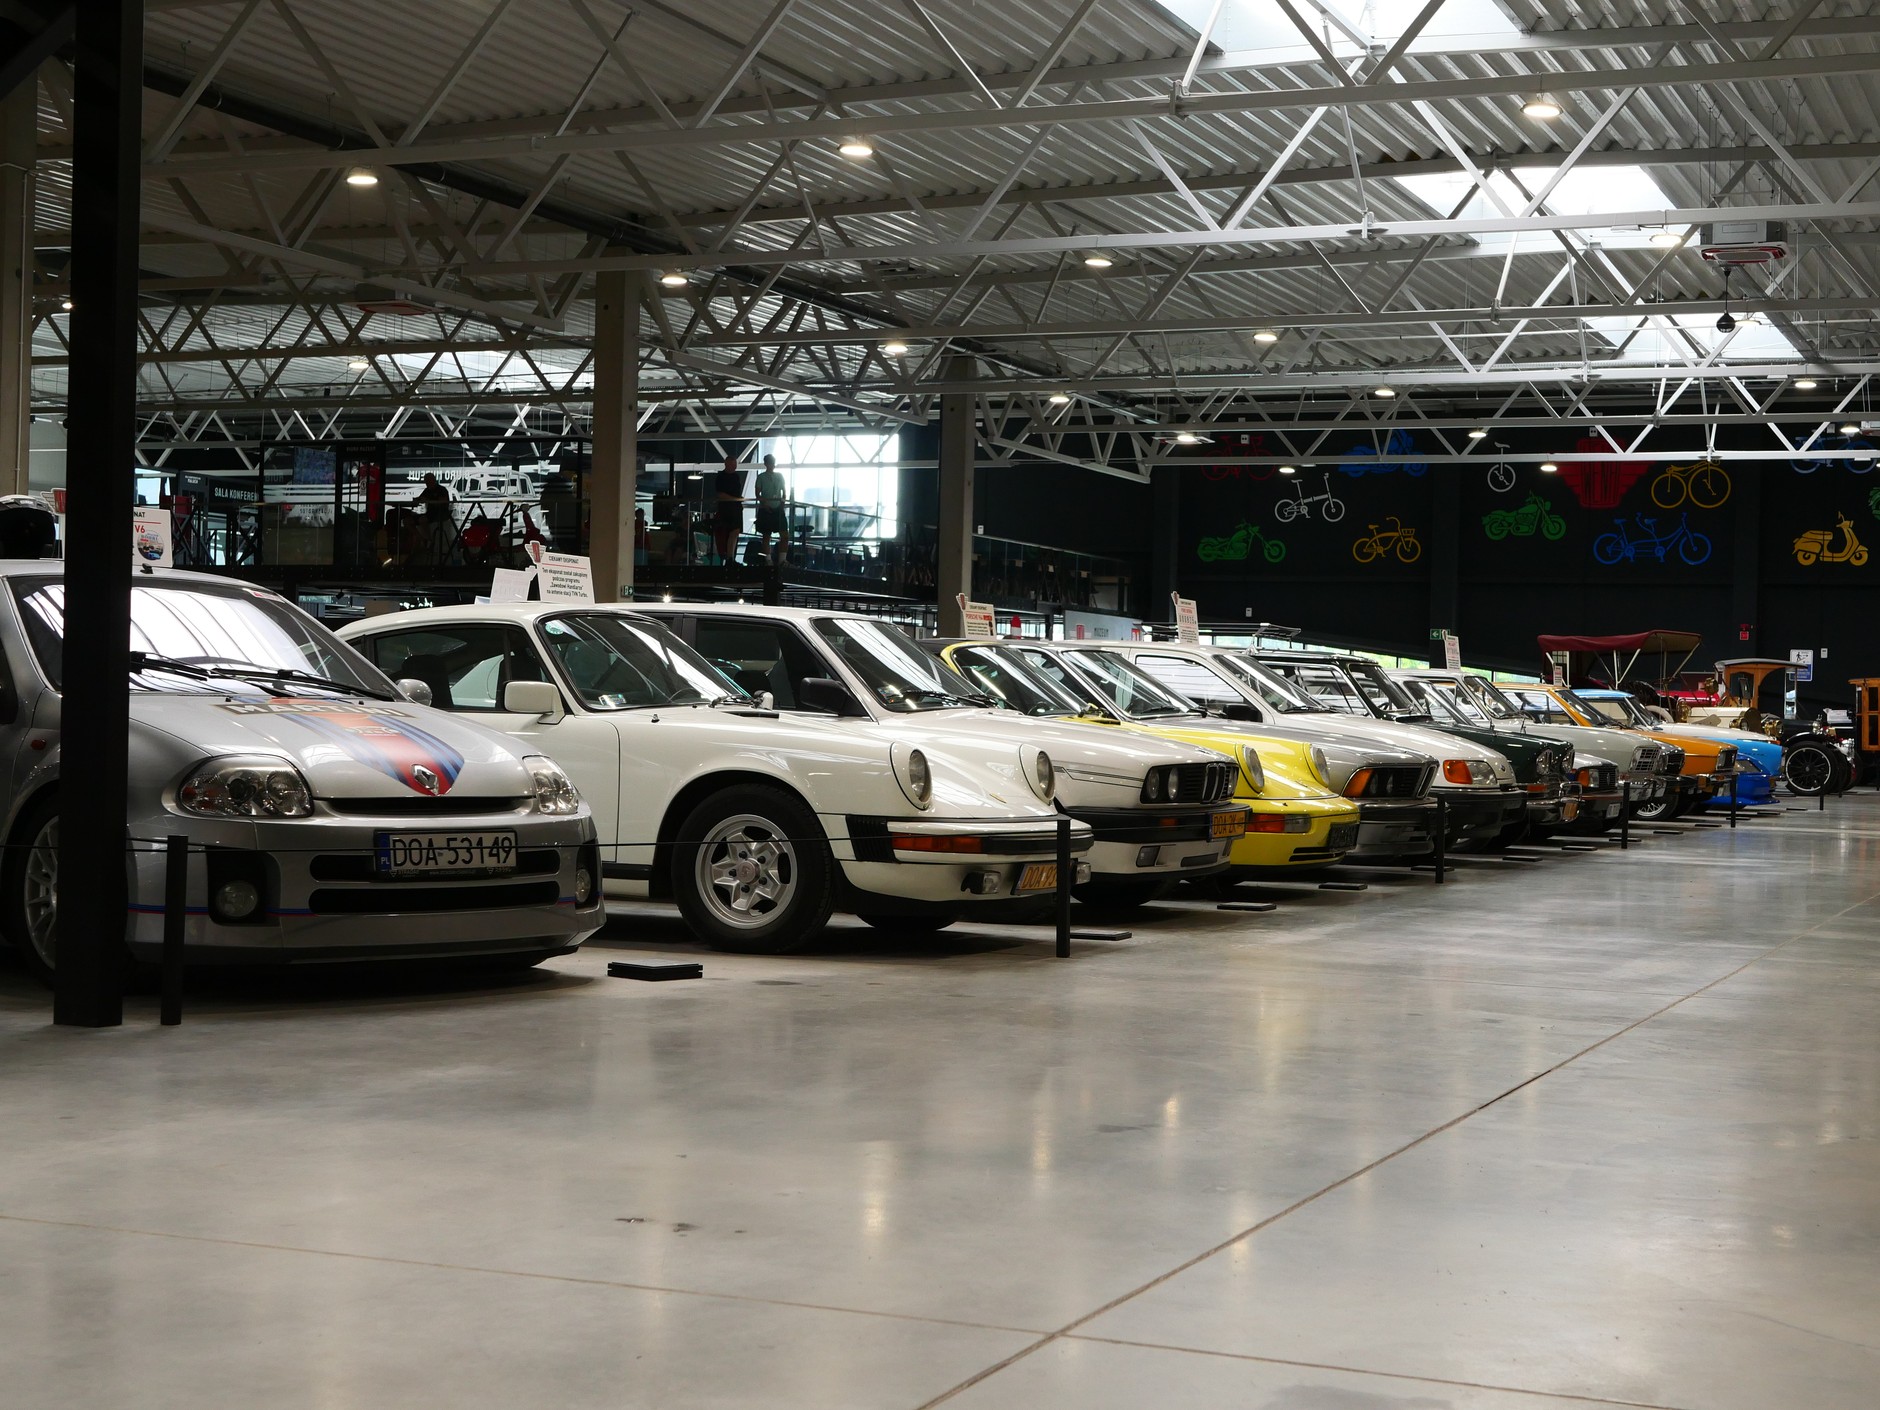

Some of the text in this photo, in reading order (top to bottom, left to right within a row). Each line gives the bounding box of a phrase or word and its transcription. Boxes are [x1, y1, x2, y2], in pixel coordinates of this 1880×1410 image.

[214, 486, 229, 498] SALA
[134, 524, 146, 534] V6
[226, 704, 405, 717] MARTINI
[446, 836, 513, 866] 53149
[380, 856, 390, 865] PL
